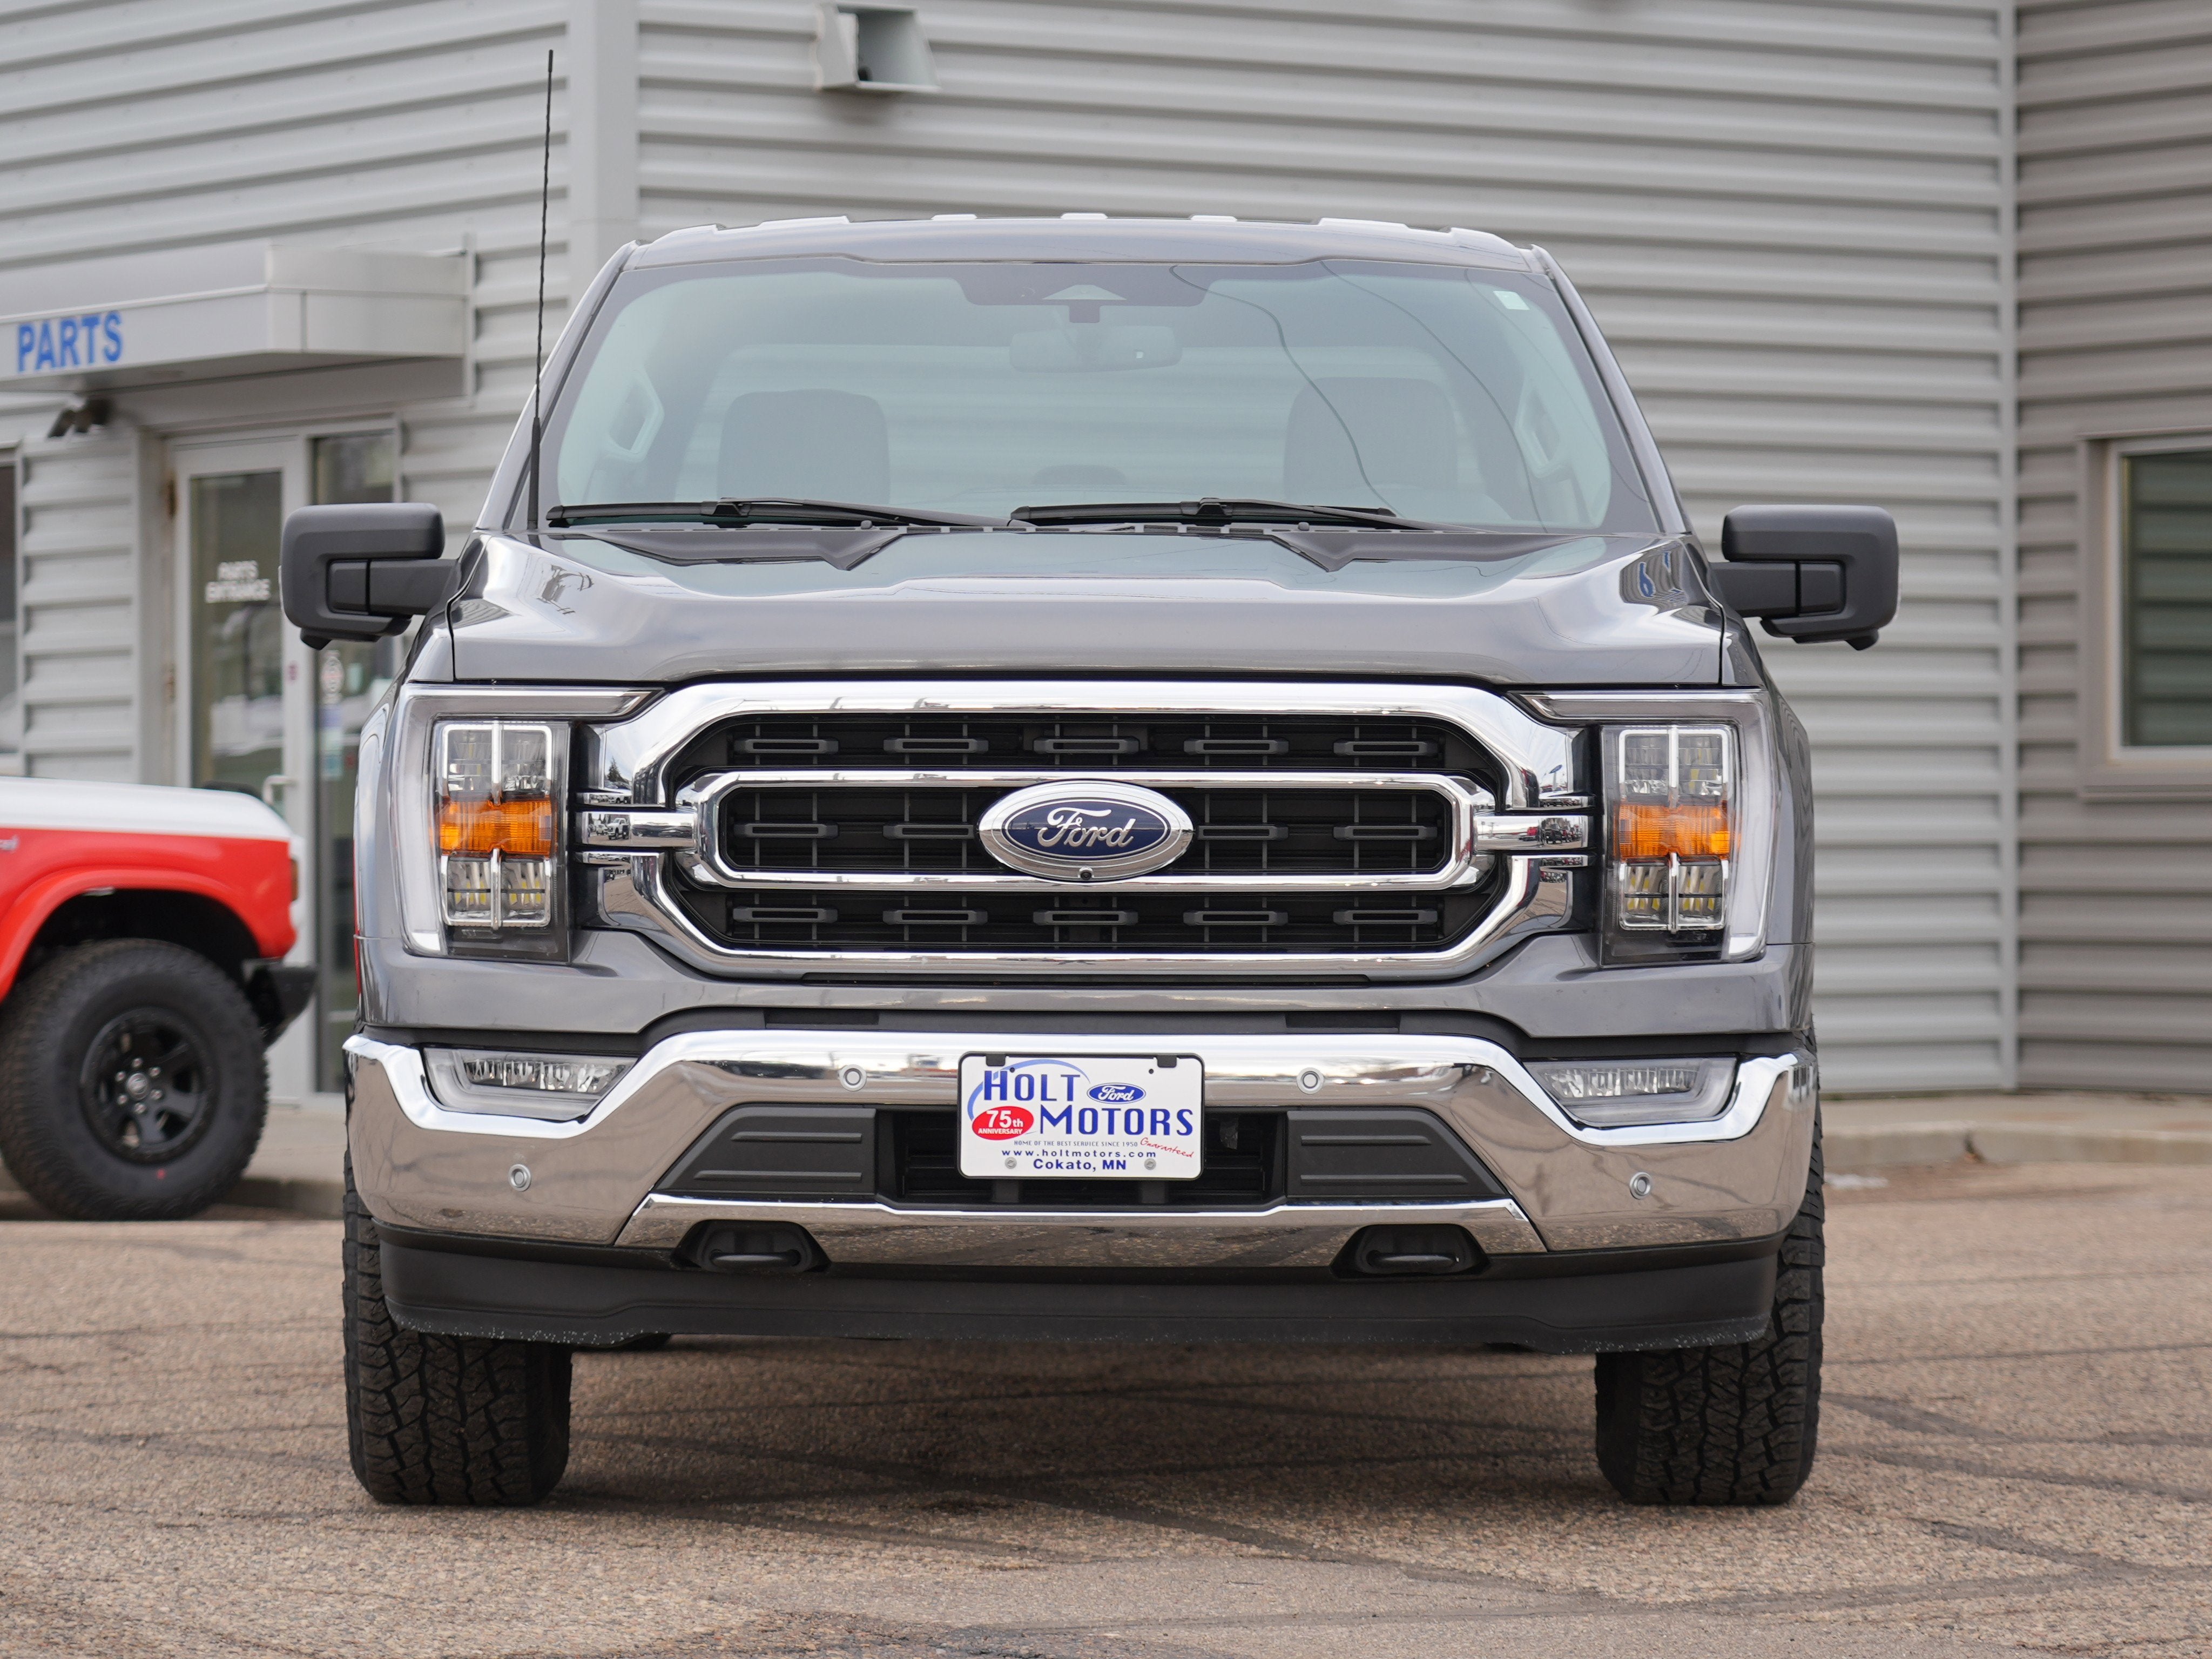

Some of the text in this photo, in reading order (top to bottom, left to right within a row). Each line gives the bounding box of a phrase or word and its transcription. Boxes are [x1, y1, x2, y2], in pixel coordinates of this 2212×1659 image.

[18, 310, 123, 372] PARTS
[1037, 807, 1136, 847] Ford
[984, 1071, 1081, 1101] HOLT
[1098, 1085, 1135, 1101] Ford
[986, 1110, 1023, 1128] 75th
[1040, 1104, 1193, 1136] MOTORS
[1002, 1149, 1156, 1157] www.holtmotors.com
[1140, 1137, 1195, 1158] Guaranteed
[1033, 1158, 1127, 1172] Cokato, MN
